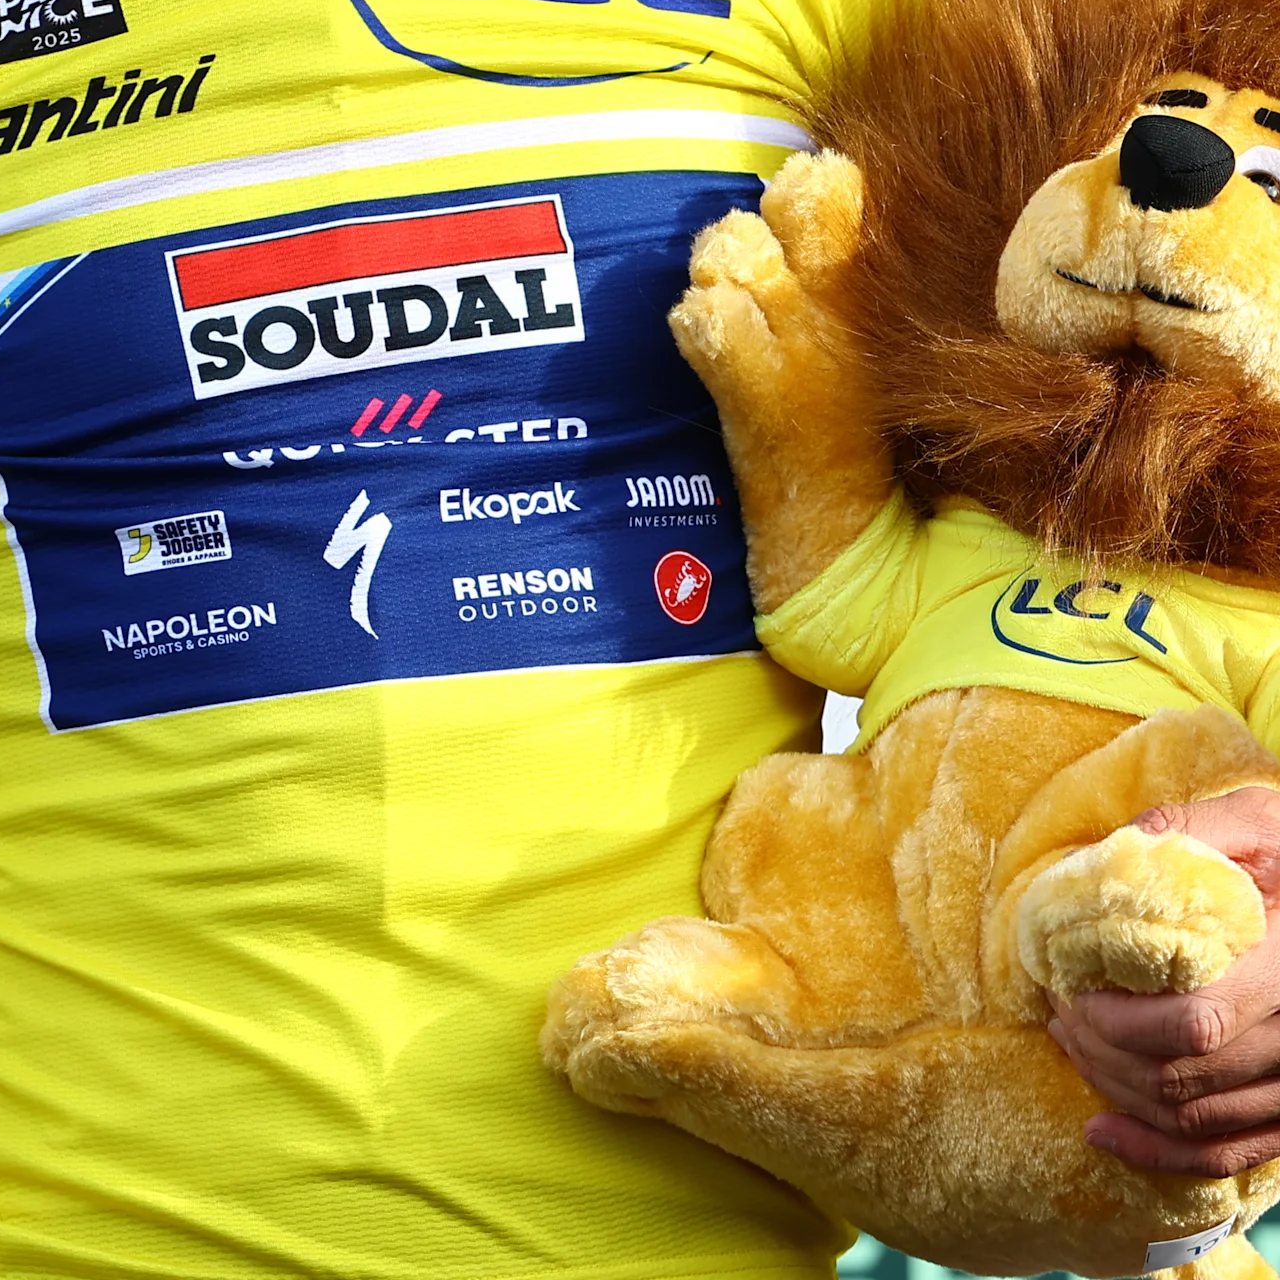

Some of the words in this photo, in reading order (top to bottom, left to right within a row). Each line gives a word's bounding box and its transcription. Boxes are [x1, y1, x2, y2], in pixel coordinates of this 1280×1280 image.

[32, 28, 82, 51] 2025
[190, 268, 576, 384] SOUDAL
[439, 482, 581, 525] Ekopak
[153, 514, 221, 541] SAFETY
[628, 514, 718, 528] INVESTMENTS
[159, 532, 226, 558] JOGGER
[452, 567, 595, 601] RENSON
[458, 596, 598, 622] OUTDOOR
[1009, 578, 1168, 655] LCL
[101, 602, 278, 653] NAPOLEON
[133, 641, 183, 660] SPORTS
[185, 639, 195, 651] &
[197, 631, 250, 648] CASINO
